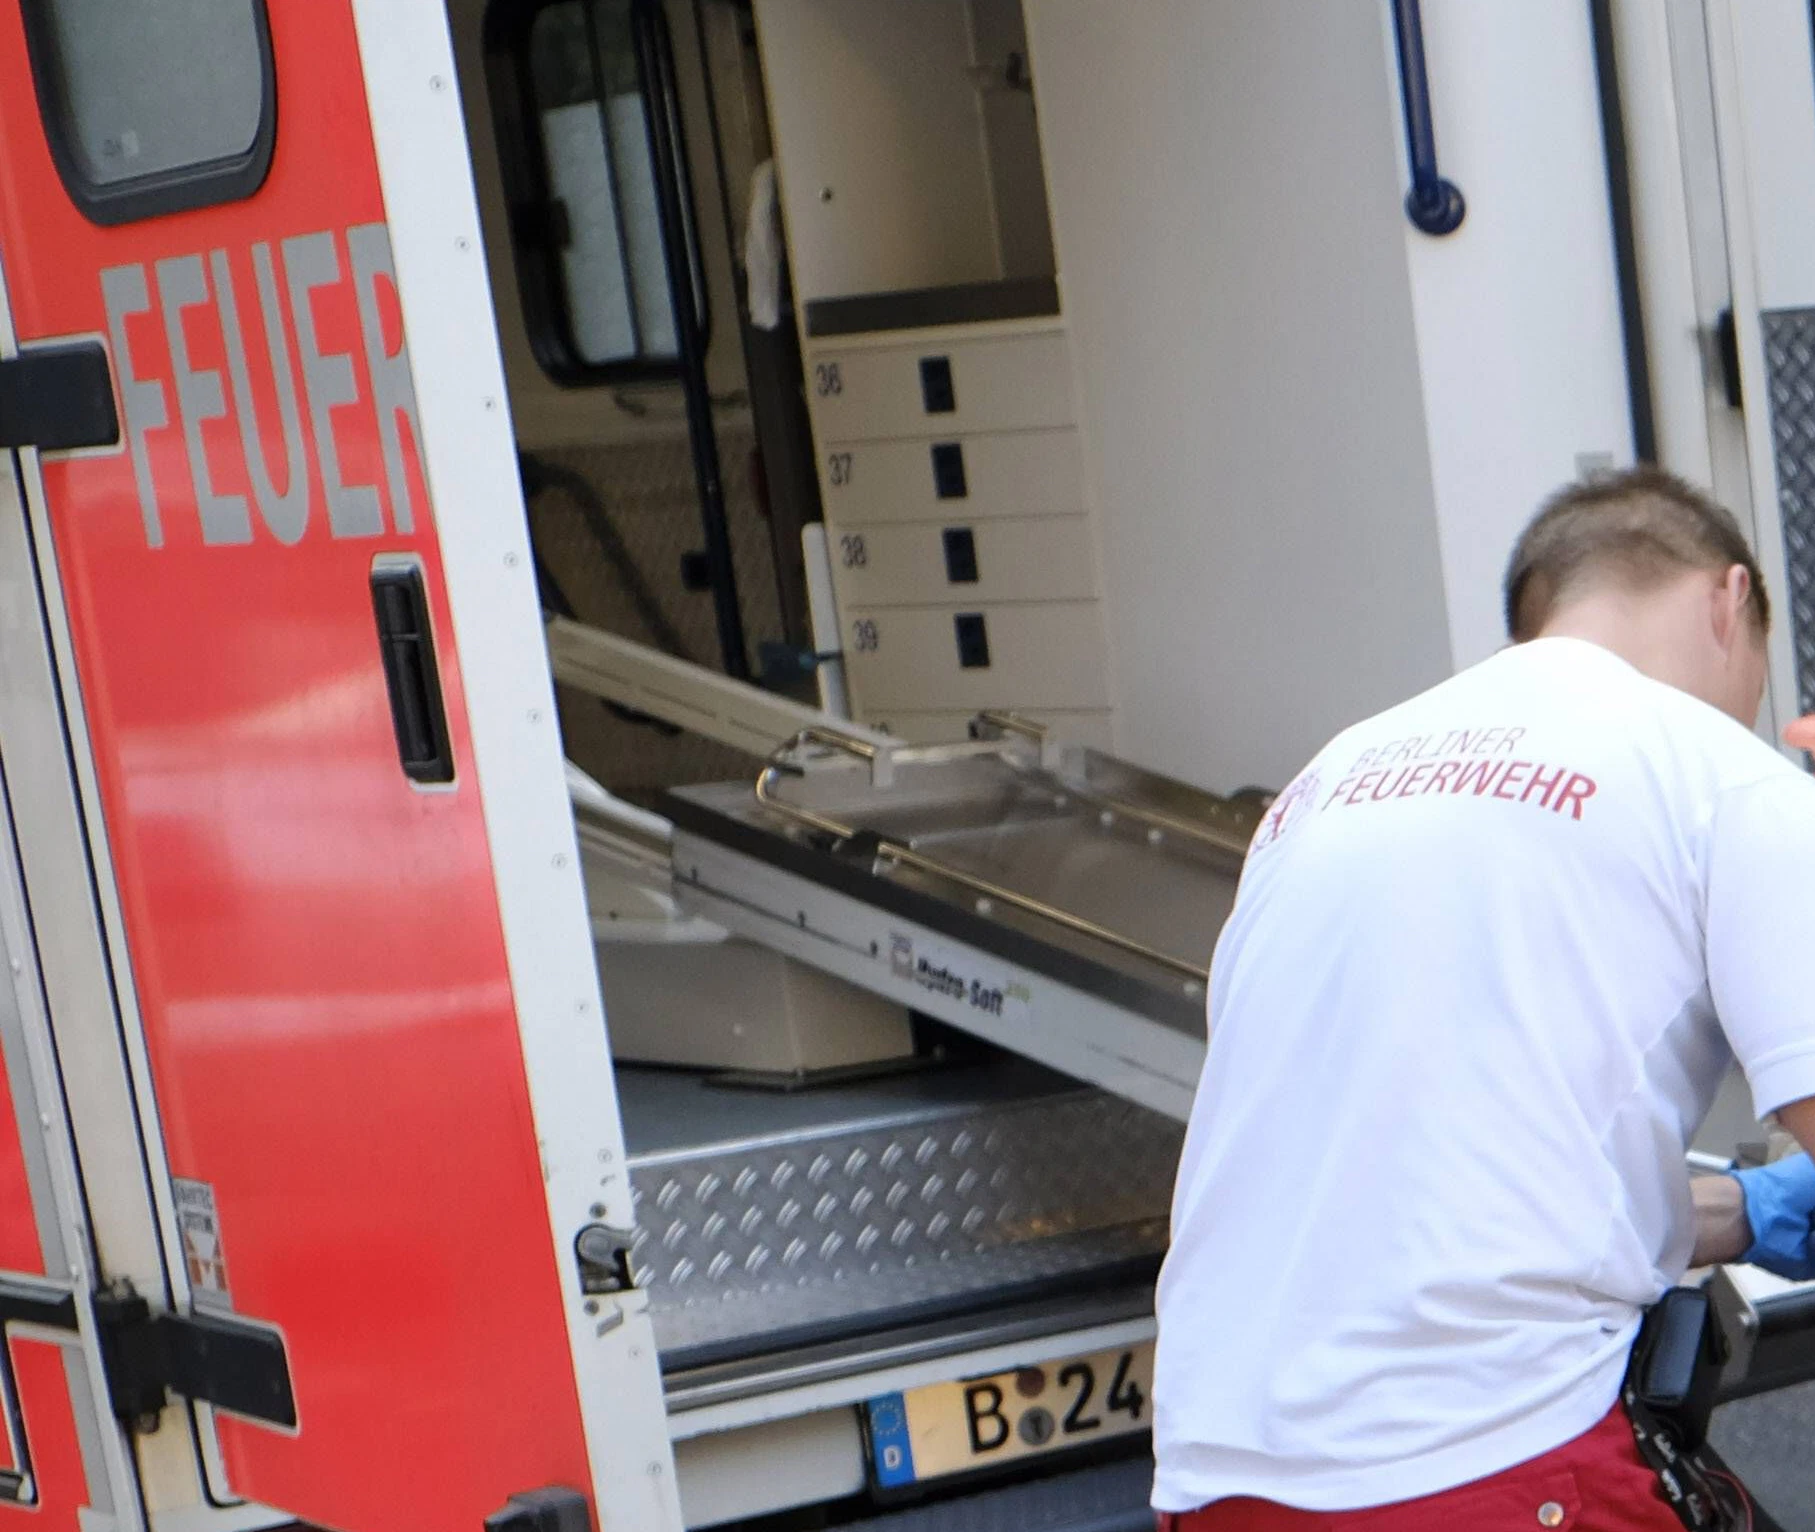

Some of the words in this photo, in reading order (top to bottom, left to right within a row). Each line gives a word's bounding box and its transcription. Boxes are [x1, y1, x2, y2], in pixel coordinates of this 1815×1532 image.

[100, 222, 432, 548] FEUER
[829, 454, 852, 486] 37
[1351, 726, 1527, 772] BERLINER
[1322, 760, 1597, 821] FEUERWEHR
[965, 1383, 1009, 1454] B
[1058, 1352, 1145, 1434] 24
